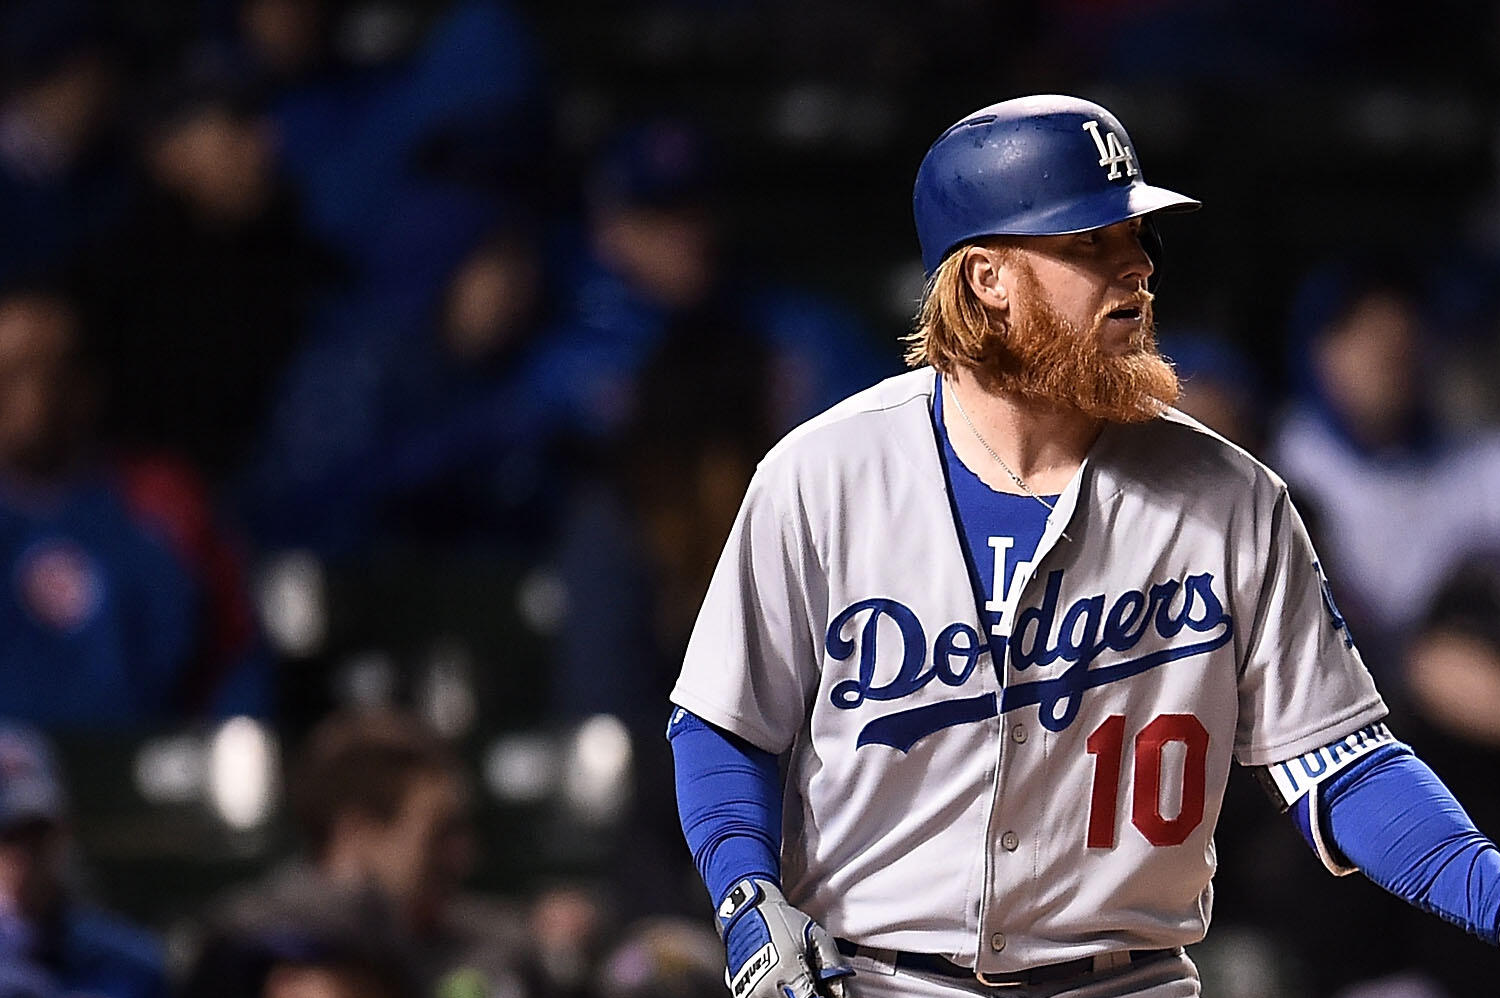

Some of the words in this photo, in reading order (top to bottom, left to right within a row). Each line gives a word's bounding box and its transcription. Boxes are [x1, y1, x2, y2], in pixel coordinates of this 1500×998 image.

[1082, 120, 1138, 181] LA
[826, 570, 1234, 732] Dodgers
[1085, 713, 1207, 849] 10
